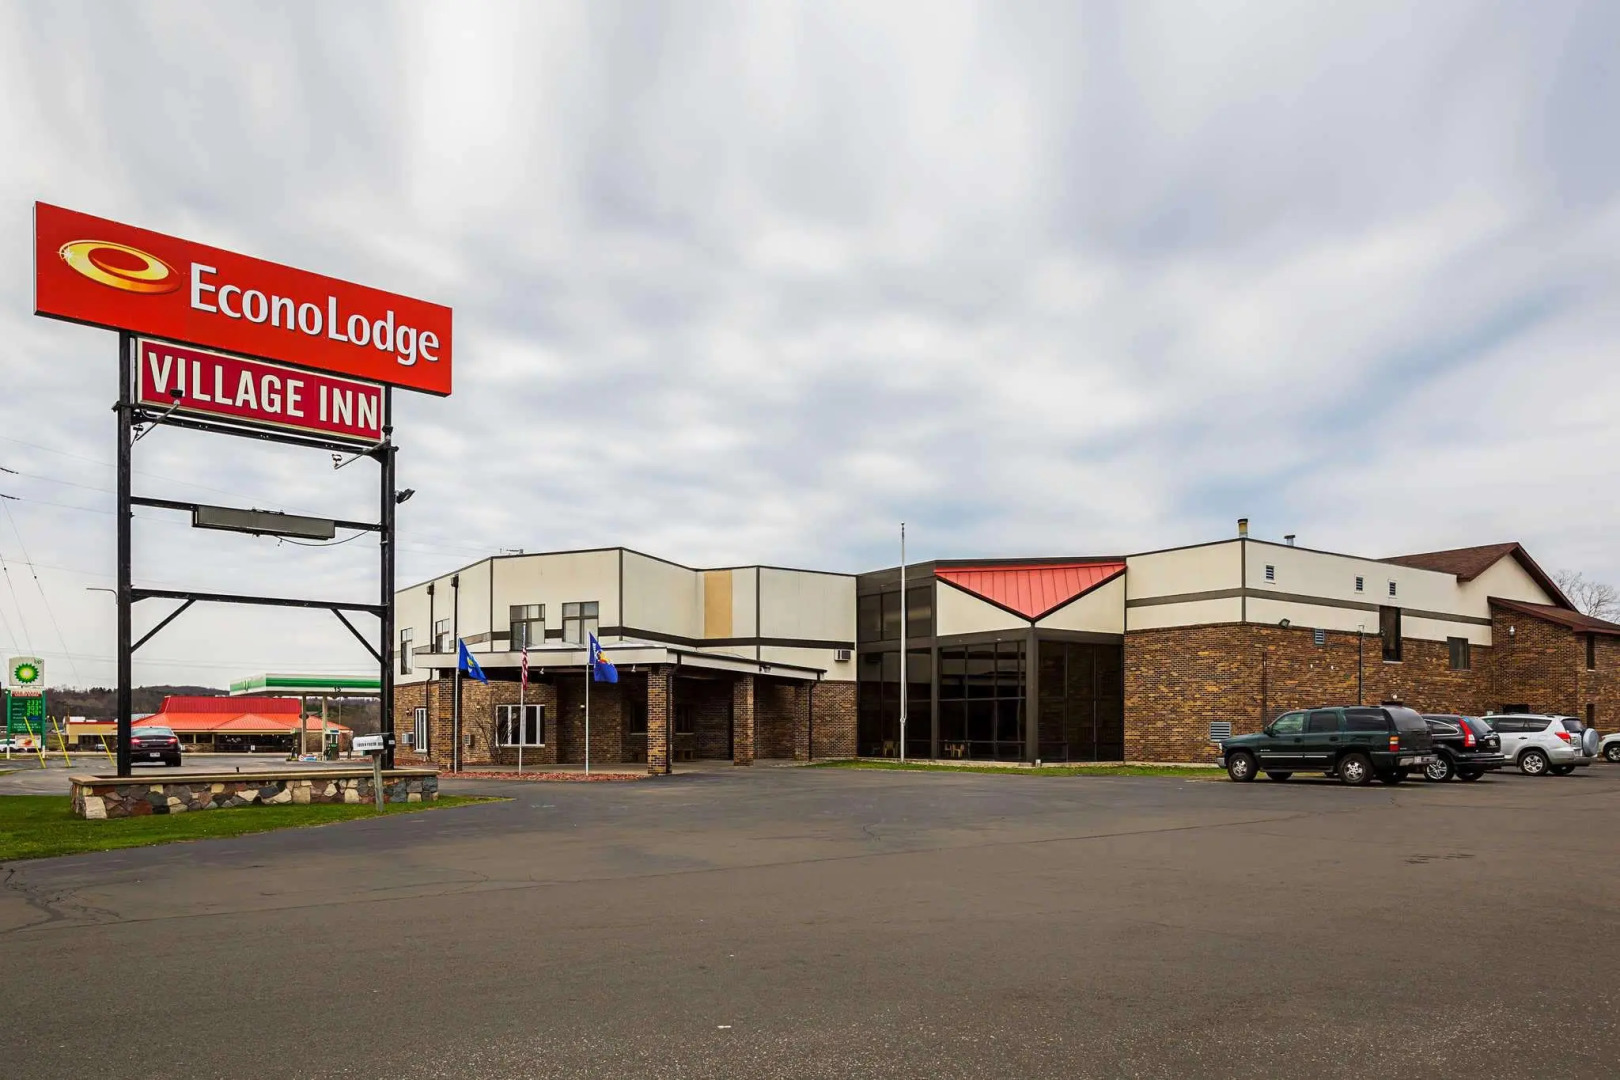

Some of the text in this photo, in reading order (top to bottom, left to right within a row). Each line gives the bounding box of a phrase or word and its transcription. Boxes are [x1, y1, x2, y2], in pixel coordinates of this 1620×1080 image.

[191, 262, 440, 366] EconoLodge
[148, 352, 378, 431] VILLAGE INN
